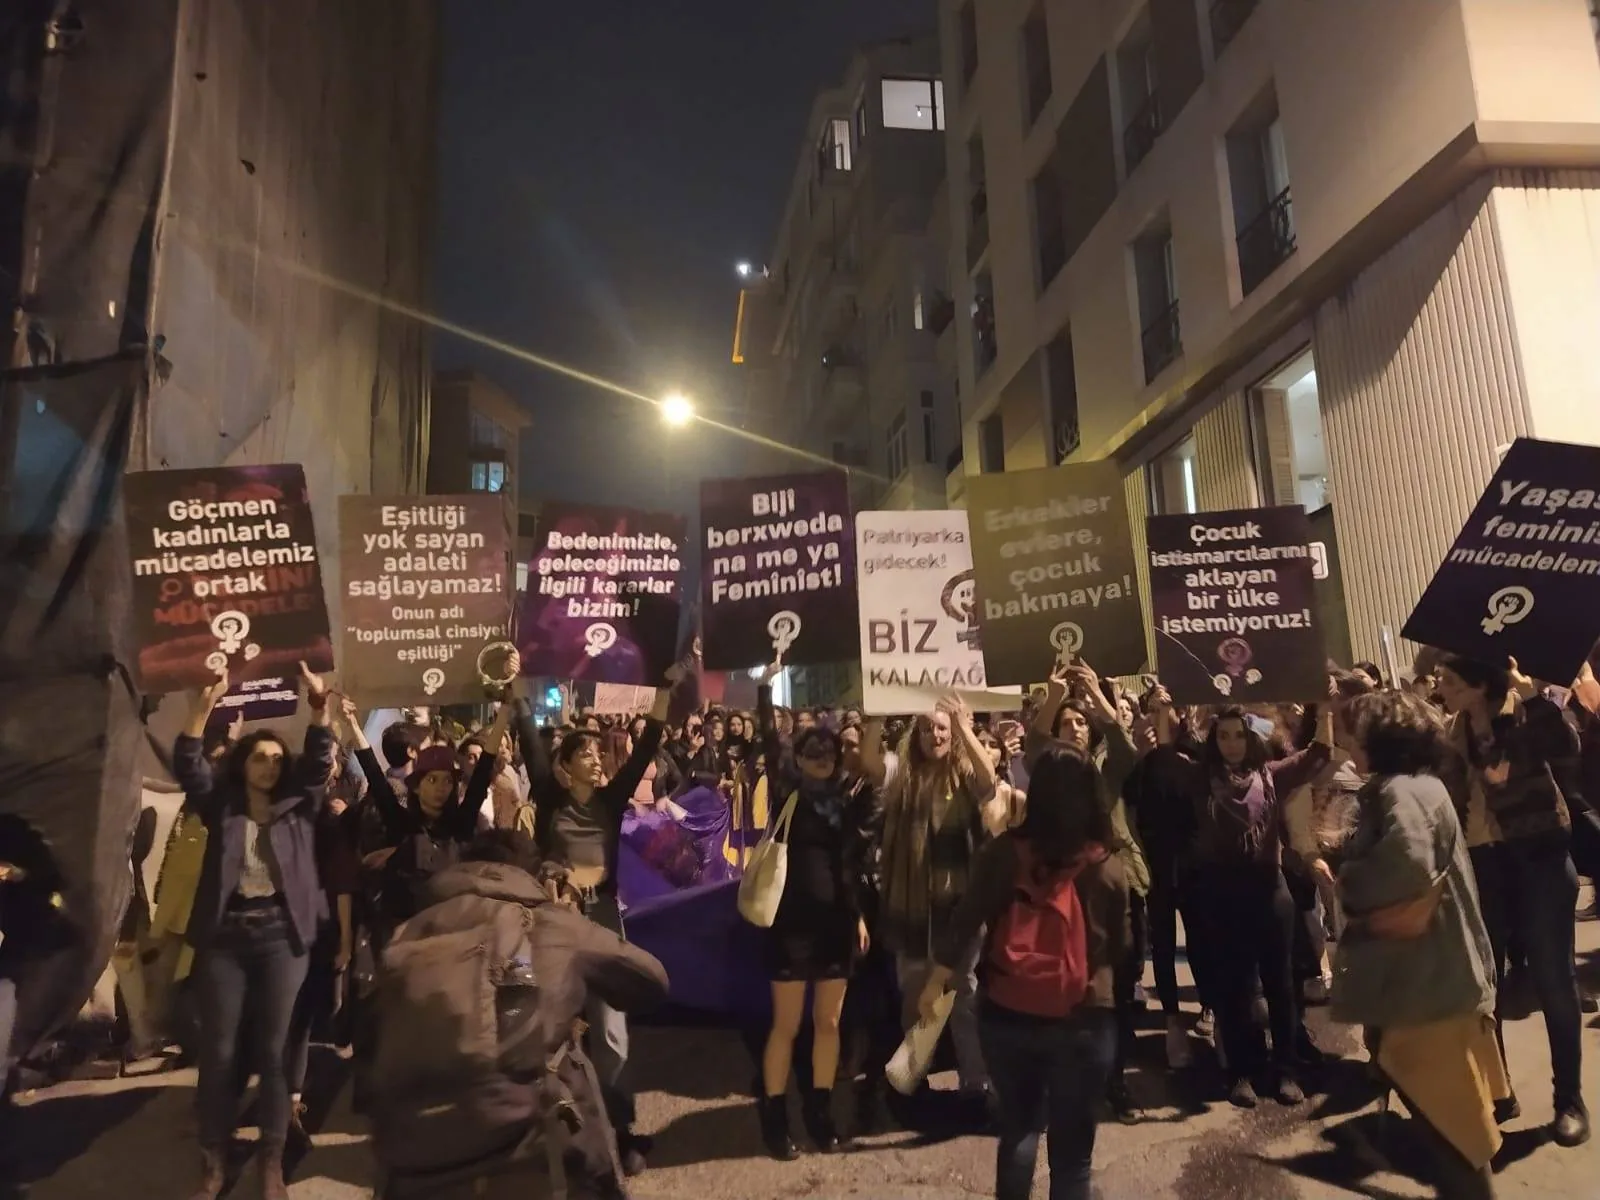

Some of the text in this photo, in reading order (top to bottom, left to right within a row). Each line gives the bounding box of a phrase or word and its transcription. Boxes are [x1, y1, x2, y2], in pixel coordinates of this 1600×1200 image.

[168, 499, 277, 523] Göçmen
[381, 505, 466, 531] Eşitliği
[153, 519, 290, 548] kadınlarla
[363, 529, 485, 553] yok sayan
[707, 511, 843, 549] berxweda
[863, 528, 965, 547] Patriyarka
[1190, 521, 1263, 546] Çocuk
[134, 542, 316, 576] mücadelemiz
[383, 551, 467, 572] adaleti
[538, 554, 681, 576] geleceğimizle
[713, 541, 840, 576] na me ya
[864, 553, 948, 574] gidecek!
[1151, 544, 1307, 567] istismarcılarını
[1008, 551, 1102, 592] çocuk
[1185, 568, 1277, 589] aklayan
[193, 571, 266, 597] ortak
[348, 573, 502, 600] sağlayamaz!
[539, 576, 675, 598] ilgili kararlar
[567, 598, 641, 618] bizim!
[984, 574, 1133, 621] bakmaya!
[1187, 588, 1280, 610] bir ülke
[391, 605, 464, 620] Onun adı
[1161, 608, 1312, 635] istemiyoruz!
[446, 623, 506, 641] cinsiyet
[868, 608, 940, 654] BİZ
